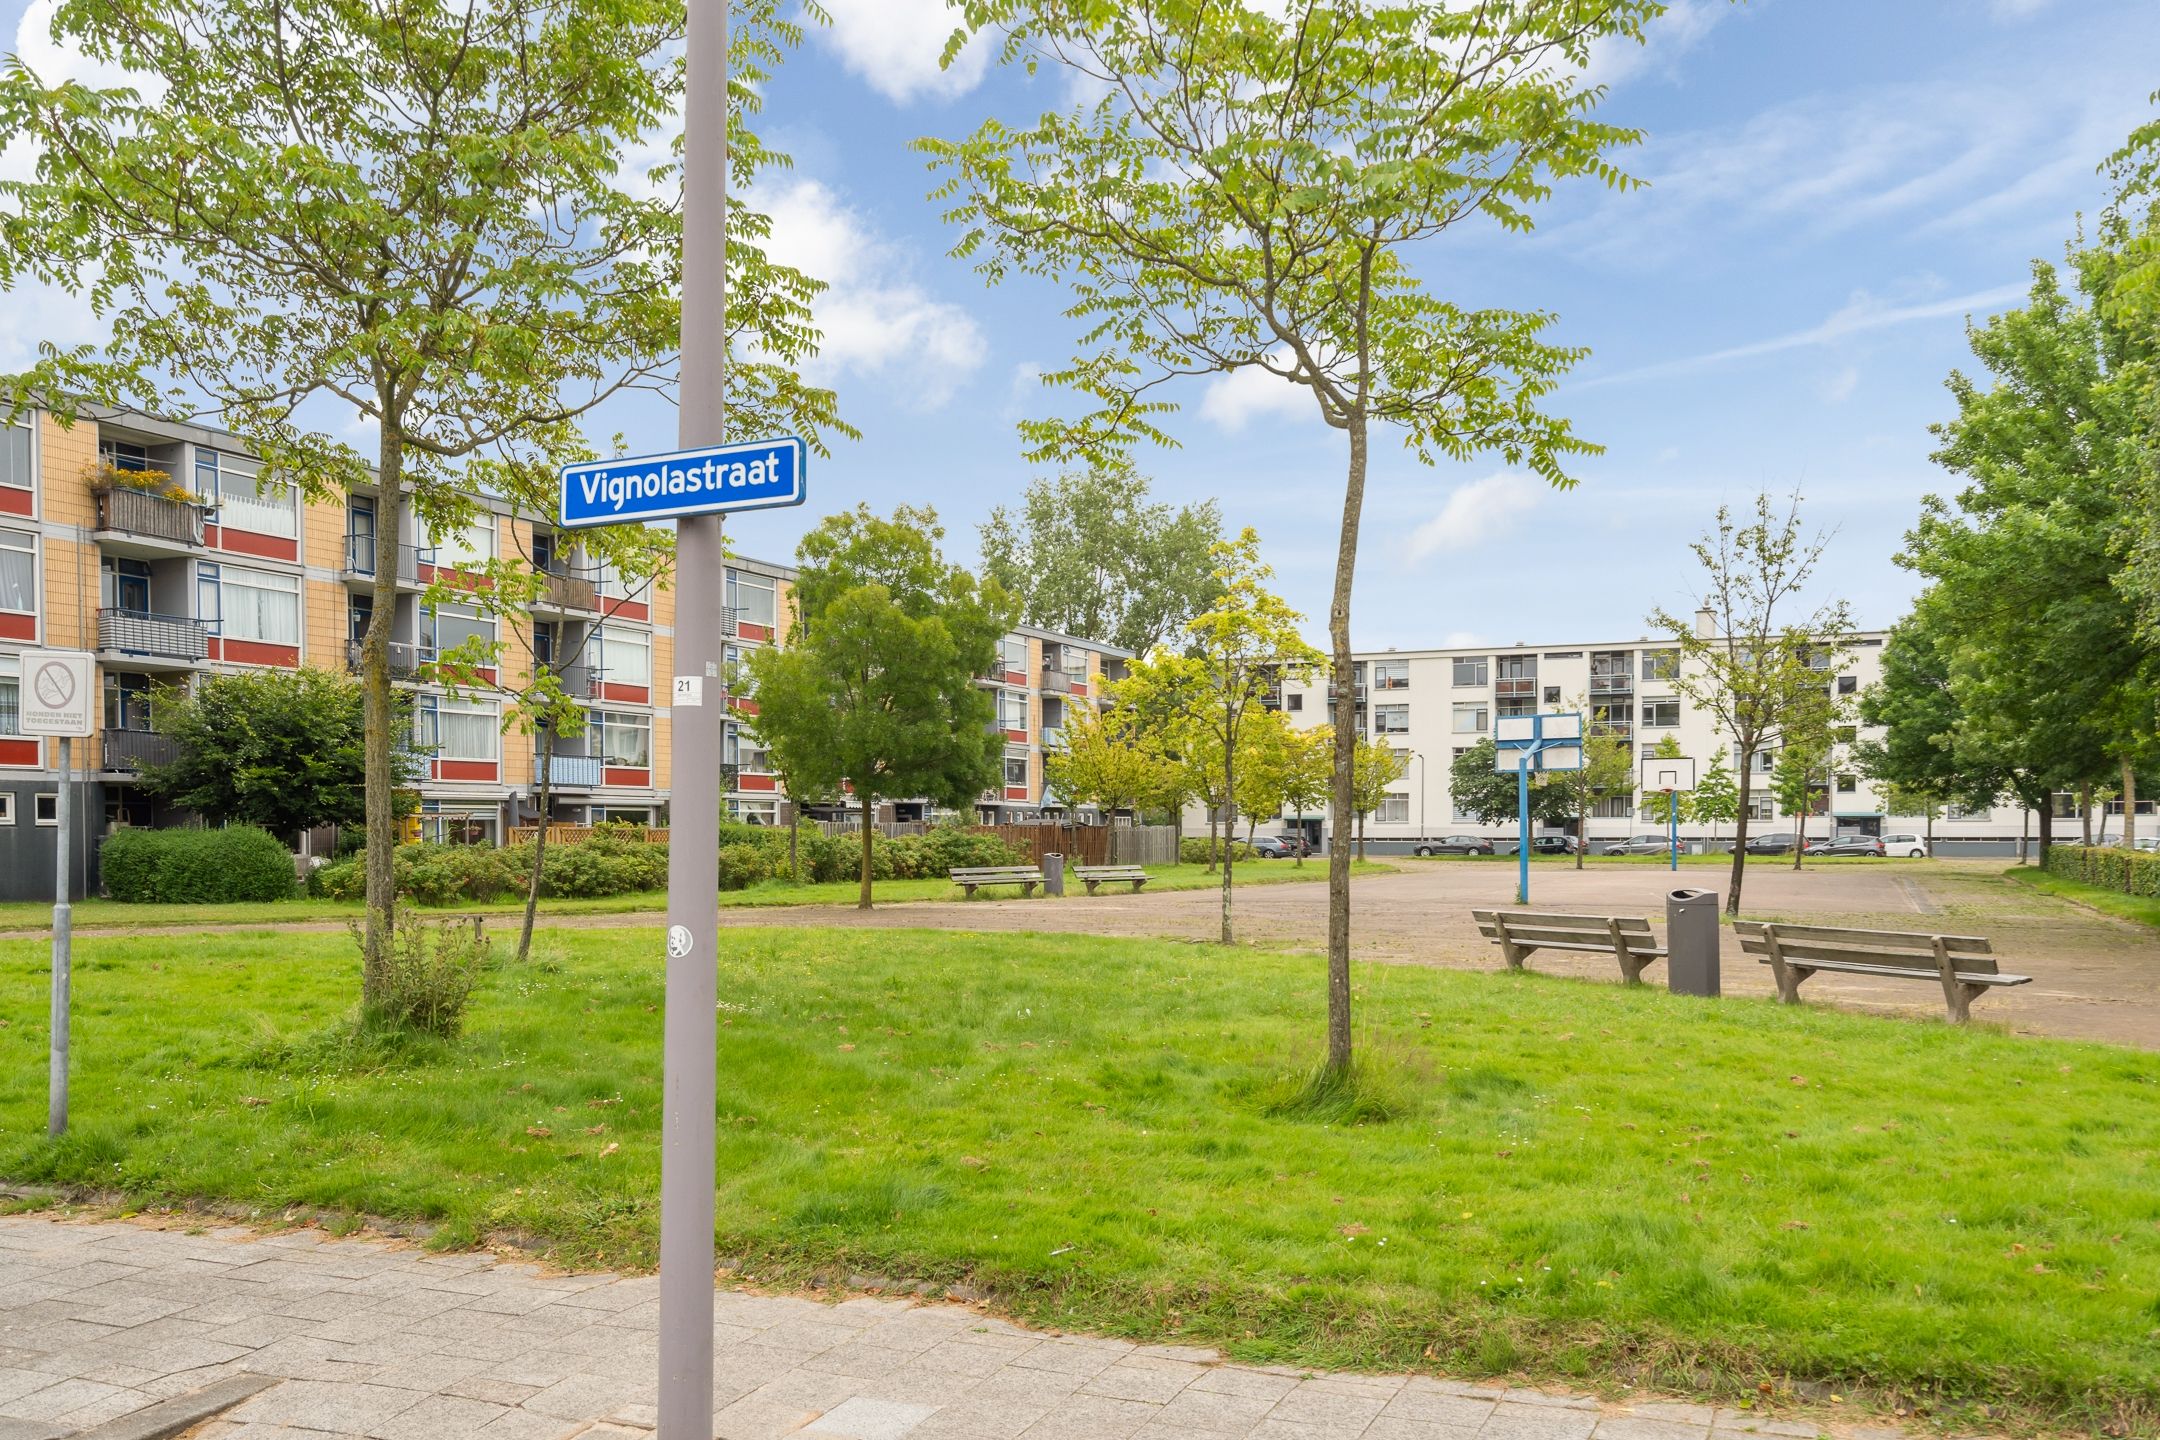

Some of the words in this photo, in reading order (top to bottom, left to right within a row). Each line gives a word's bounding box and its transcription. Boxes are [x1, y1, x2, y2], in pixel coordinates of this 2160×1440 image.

[579, 451, 780, 512] Vignolastraat
[678, 680, 690, 692] 21
[26, 717, 83, 726] TOEGESTAAN
